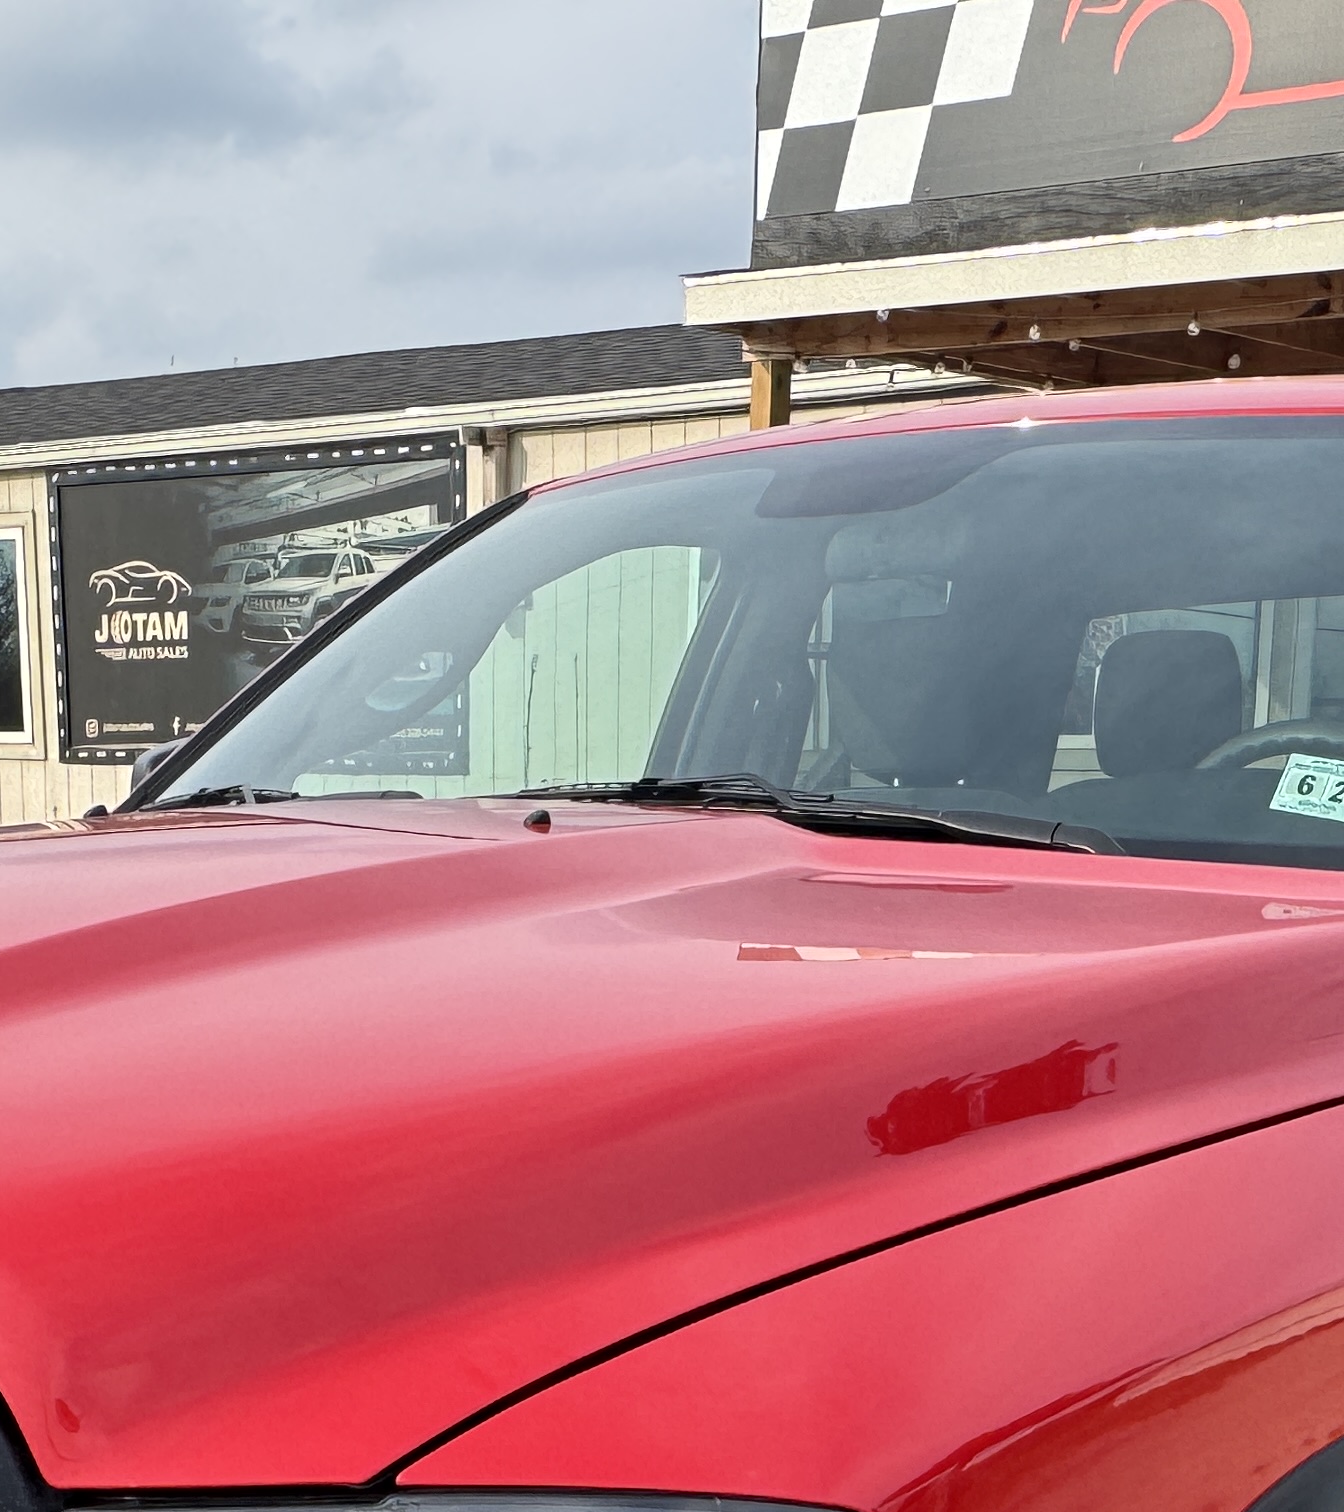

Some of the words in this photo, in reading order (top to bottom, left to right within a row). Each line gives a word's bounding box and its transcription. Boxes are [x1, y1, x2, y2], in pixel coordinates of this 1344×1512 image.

[95, 610, 189, 644] JOTAM
[128, 647, 155, 660] AUTO
[156, 645, 189, 660] SALES
[1297, 774, 1317, 796] 6
